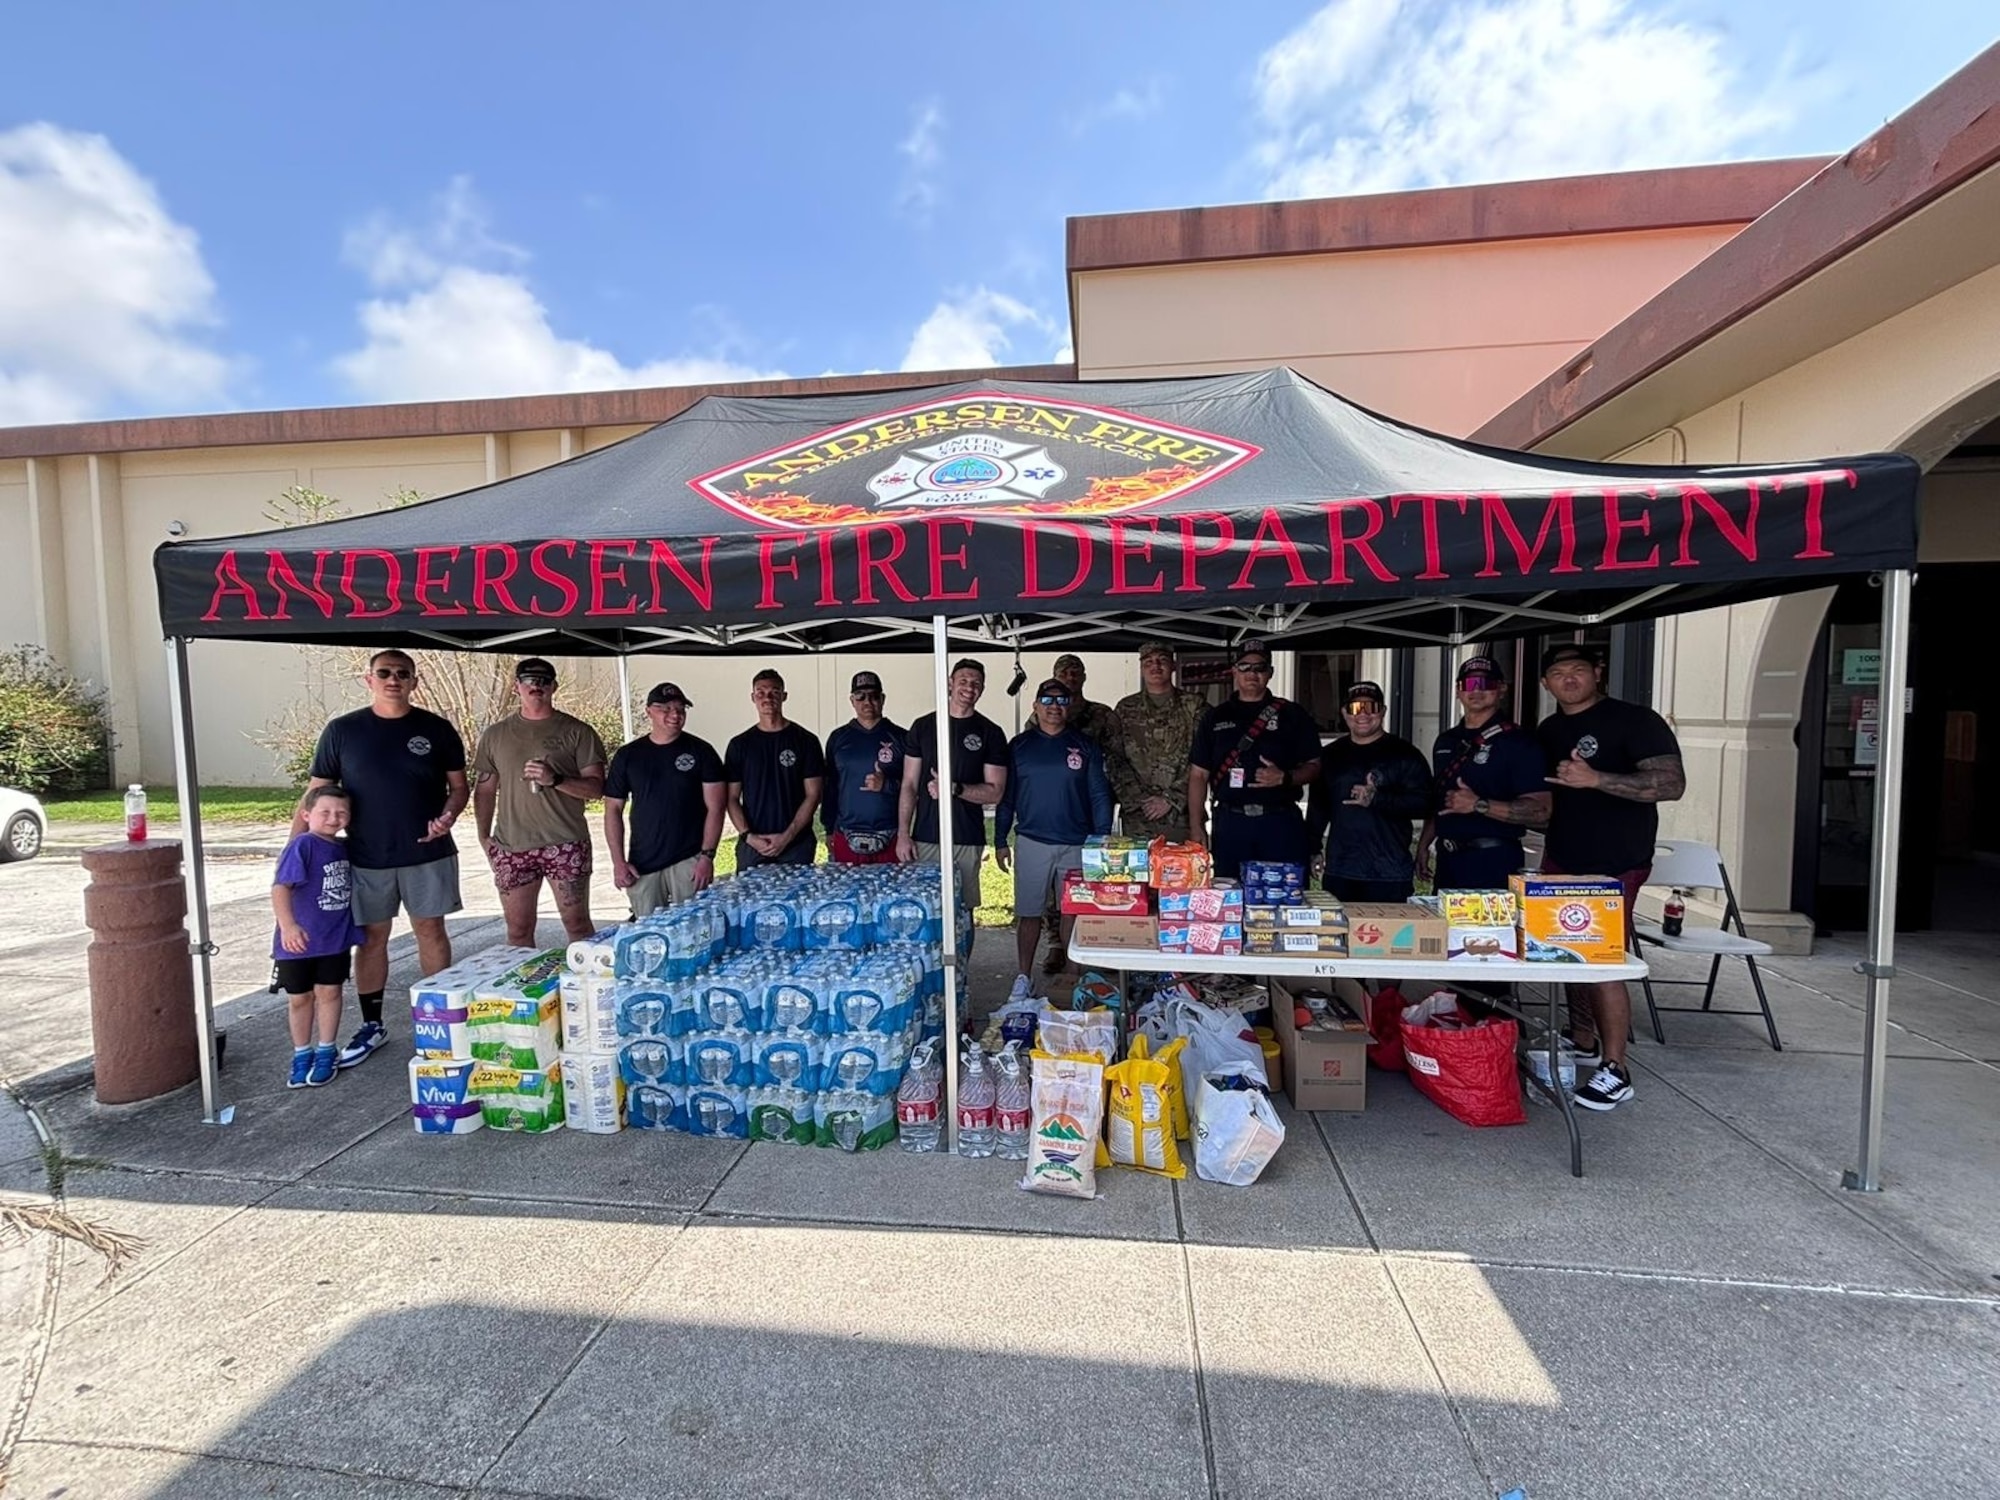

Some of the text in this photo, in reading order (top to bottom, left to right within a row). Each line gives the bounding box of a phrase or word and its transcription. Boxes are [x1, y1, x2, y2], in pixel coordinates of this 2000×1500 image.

[742, 404, 1221, 490] ANDERSEN FIRE
[803, 420, 1007, 474] EMERGENCY
[1013, 421, 1157, 462] SERVICES
[939, 437, 1003, 451] UNITED
[940, 444, 1000, 456] STATES
[200, 468, 1858, 621] ANDERSEN FIRE DEPARTMENT
[1250, 932, 1273, 940] SPAM
[1315, 965, 1336, 975] AFD
[416, 1024, 447, 1040] Viva
[422, 1086, 456, 1103] Viva
